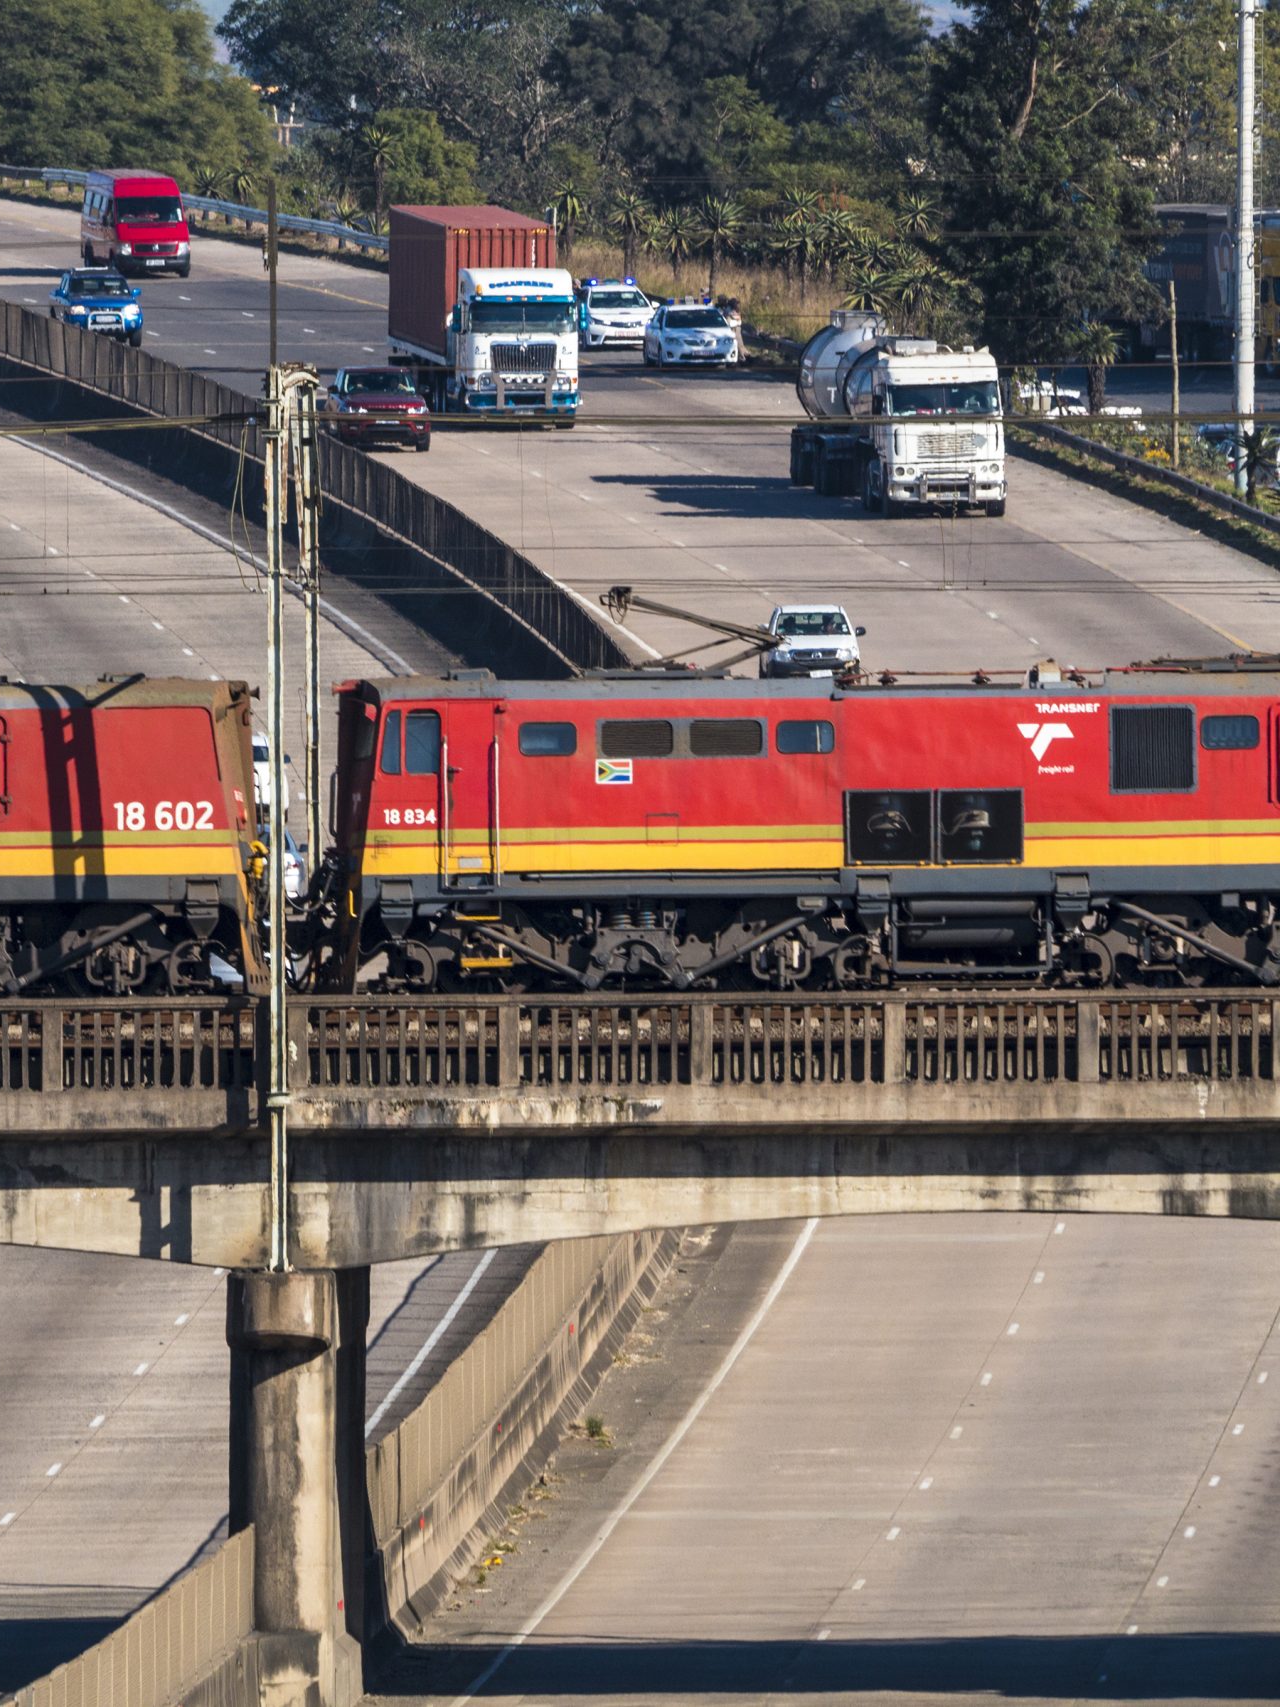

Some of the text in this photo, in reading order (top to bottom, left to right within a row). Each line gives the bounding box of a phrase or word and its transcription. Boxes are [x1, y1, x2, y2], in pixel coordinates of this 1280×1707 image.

[1034, 703, 1101, 714] TRANSNET
[113, 800, 214, 831] 18 602
[383, 808, 437, 825] 18 834
